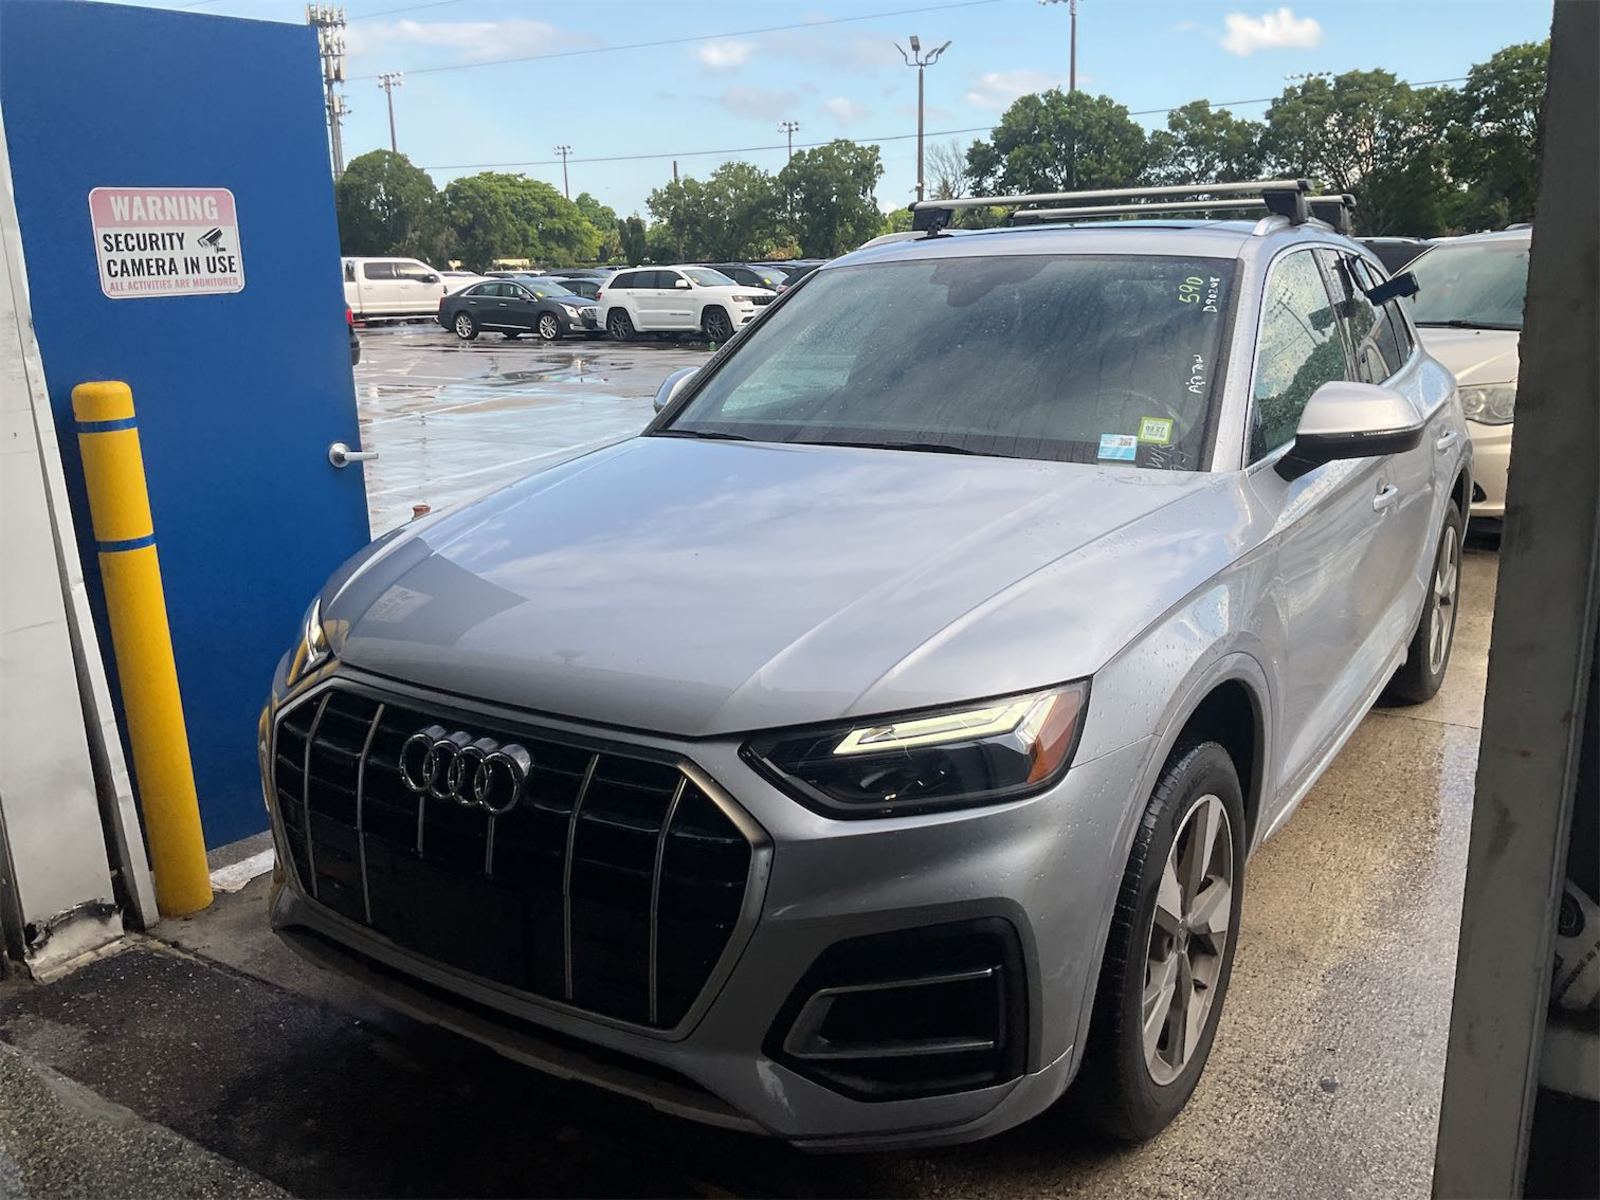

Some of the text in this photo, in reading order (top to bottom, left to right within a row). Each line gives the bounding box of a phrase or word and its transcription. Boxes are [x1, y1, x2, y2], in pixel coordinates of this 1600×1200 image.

[109, 194, 219, 222] WARNING
[103, 232, 185, 252] SECURITY
[107, 255, 237, 278] CAMERA IN USE
[109, 276, 239, 292] ALL ACTIVITIES ARE MONITORED
[1179, 276, 1204, 304] 590
